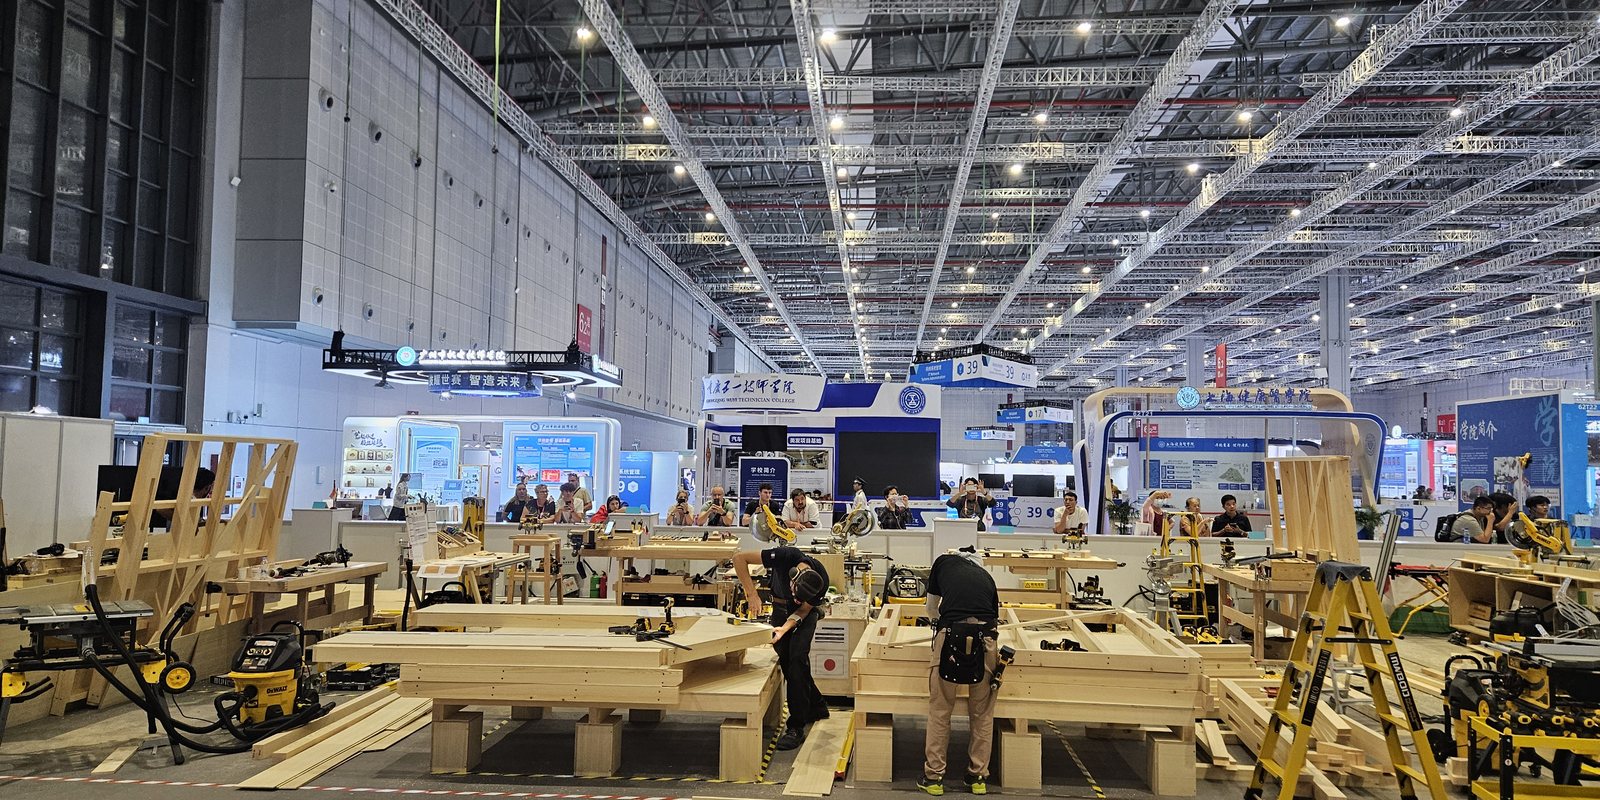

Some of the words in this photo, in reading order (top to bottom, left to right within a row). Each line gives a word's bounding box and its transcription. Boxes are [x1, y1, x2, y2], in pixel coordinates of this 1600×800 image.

[966, 360, 978, 374] 39
[1006, 365, 1014, 379] 39
[469, 374, 520, 387] 智造未来
[1460, 419, 1498, 440] 学院简介
[1027, 507, 1042, 518] 39
